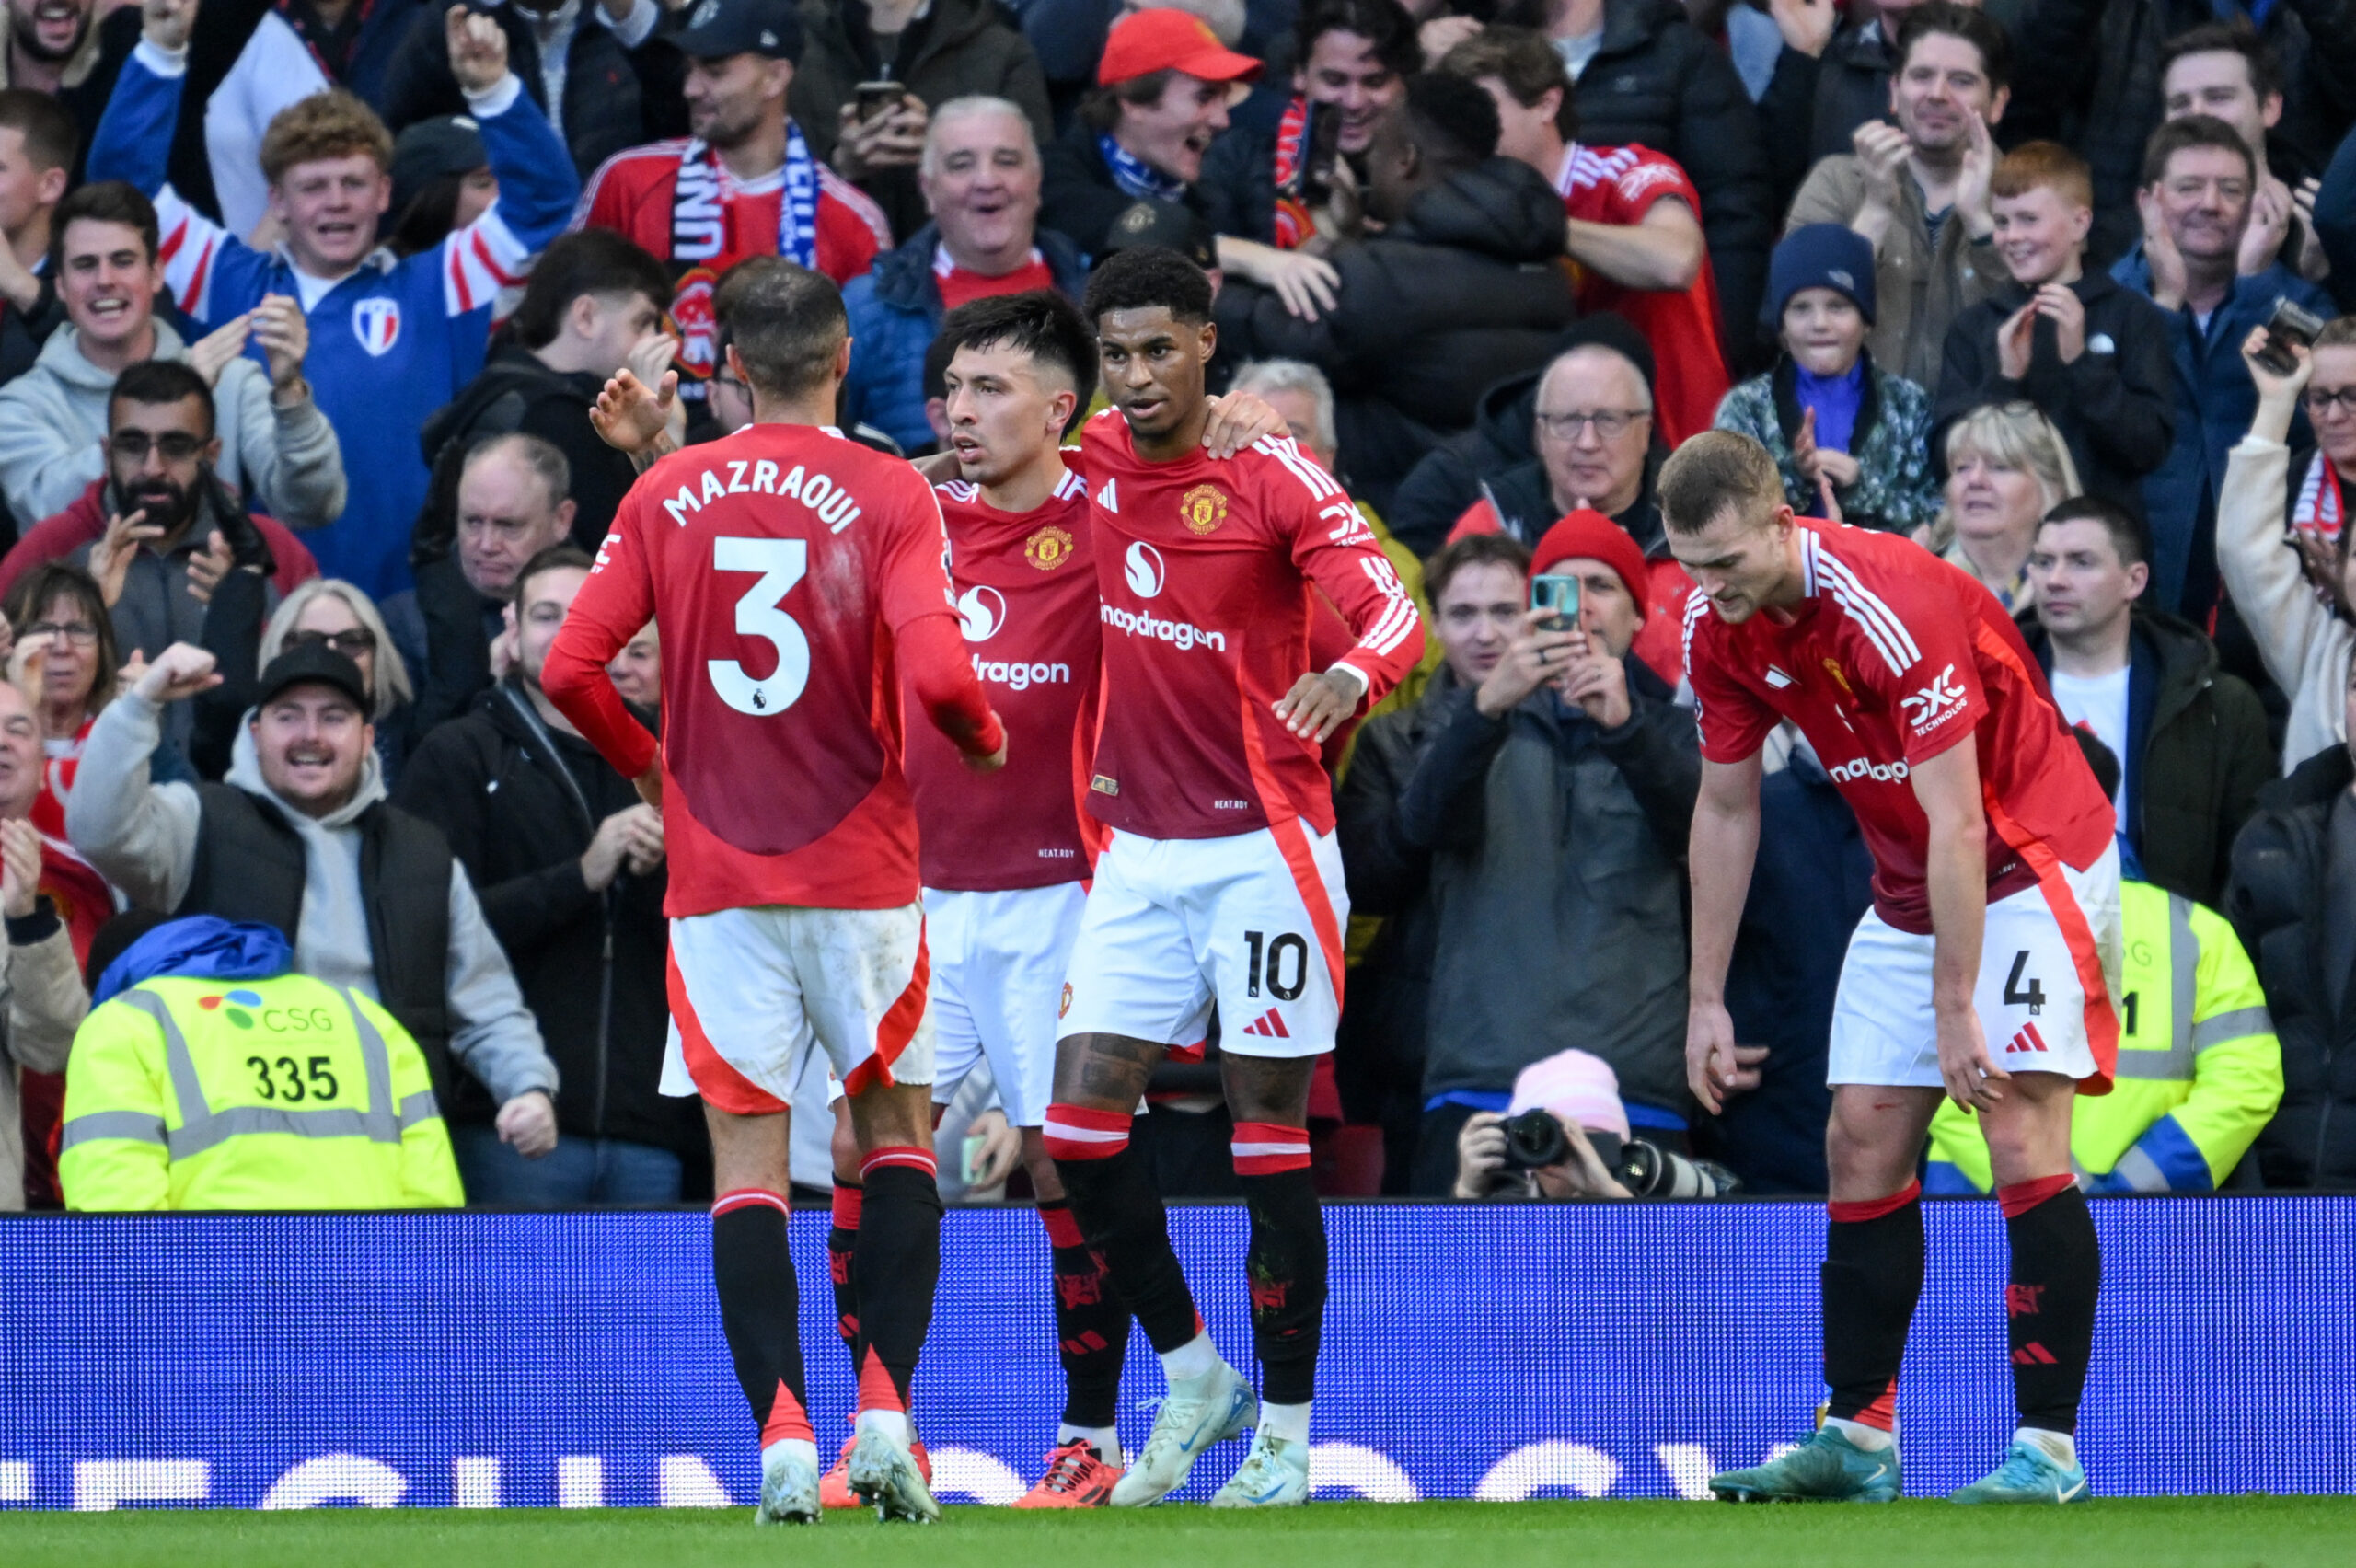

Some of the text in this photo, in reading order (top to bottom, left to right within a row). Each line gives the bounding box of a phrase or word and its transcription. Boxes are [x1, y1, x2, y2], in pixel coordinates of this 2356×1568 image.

[663, 459, 861, 536] MAZRAOUI
[708, 536, 811, 716] 3
[1900, 663, 1967, 727] DXC
[1914, 696, 1968, 737] TECHNOLOG
[1038, 847, 1075, 859] HEAT.RDY
[1243, 929, 1308, 1001] 10
[2004, 950, 2047, 1016] 4
[262, 1007, 334, 1033] CSG
[246, 1055, 340, 1103] 335
